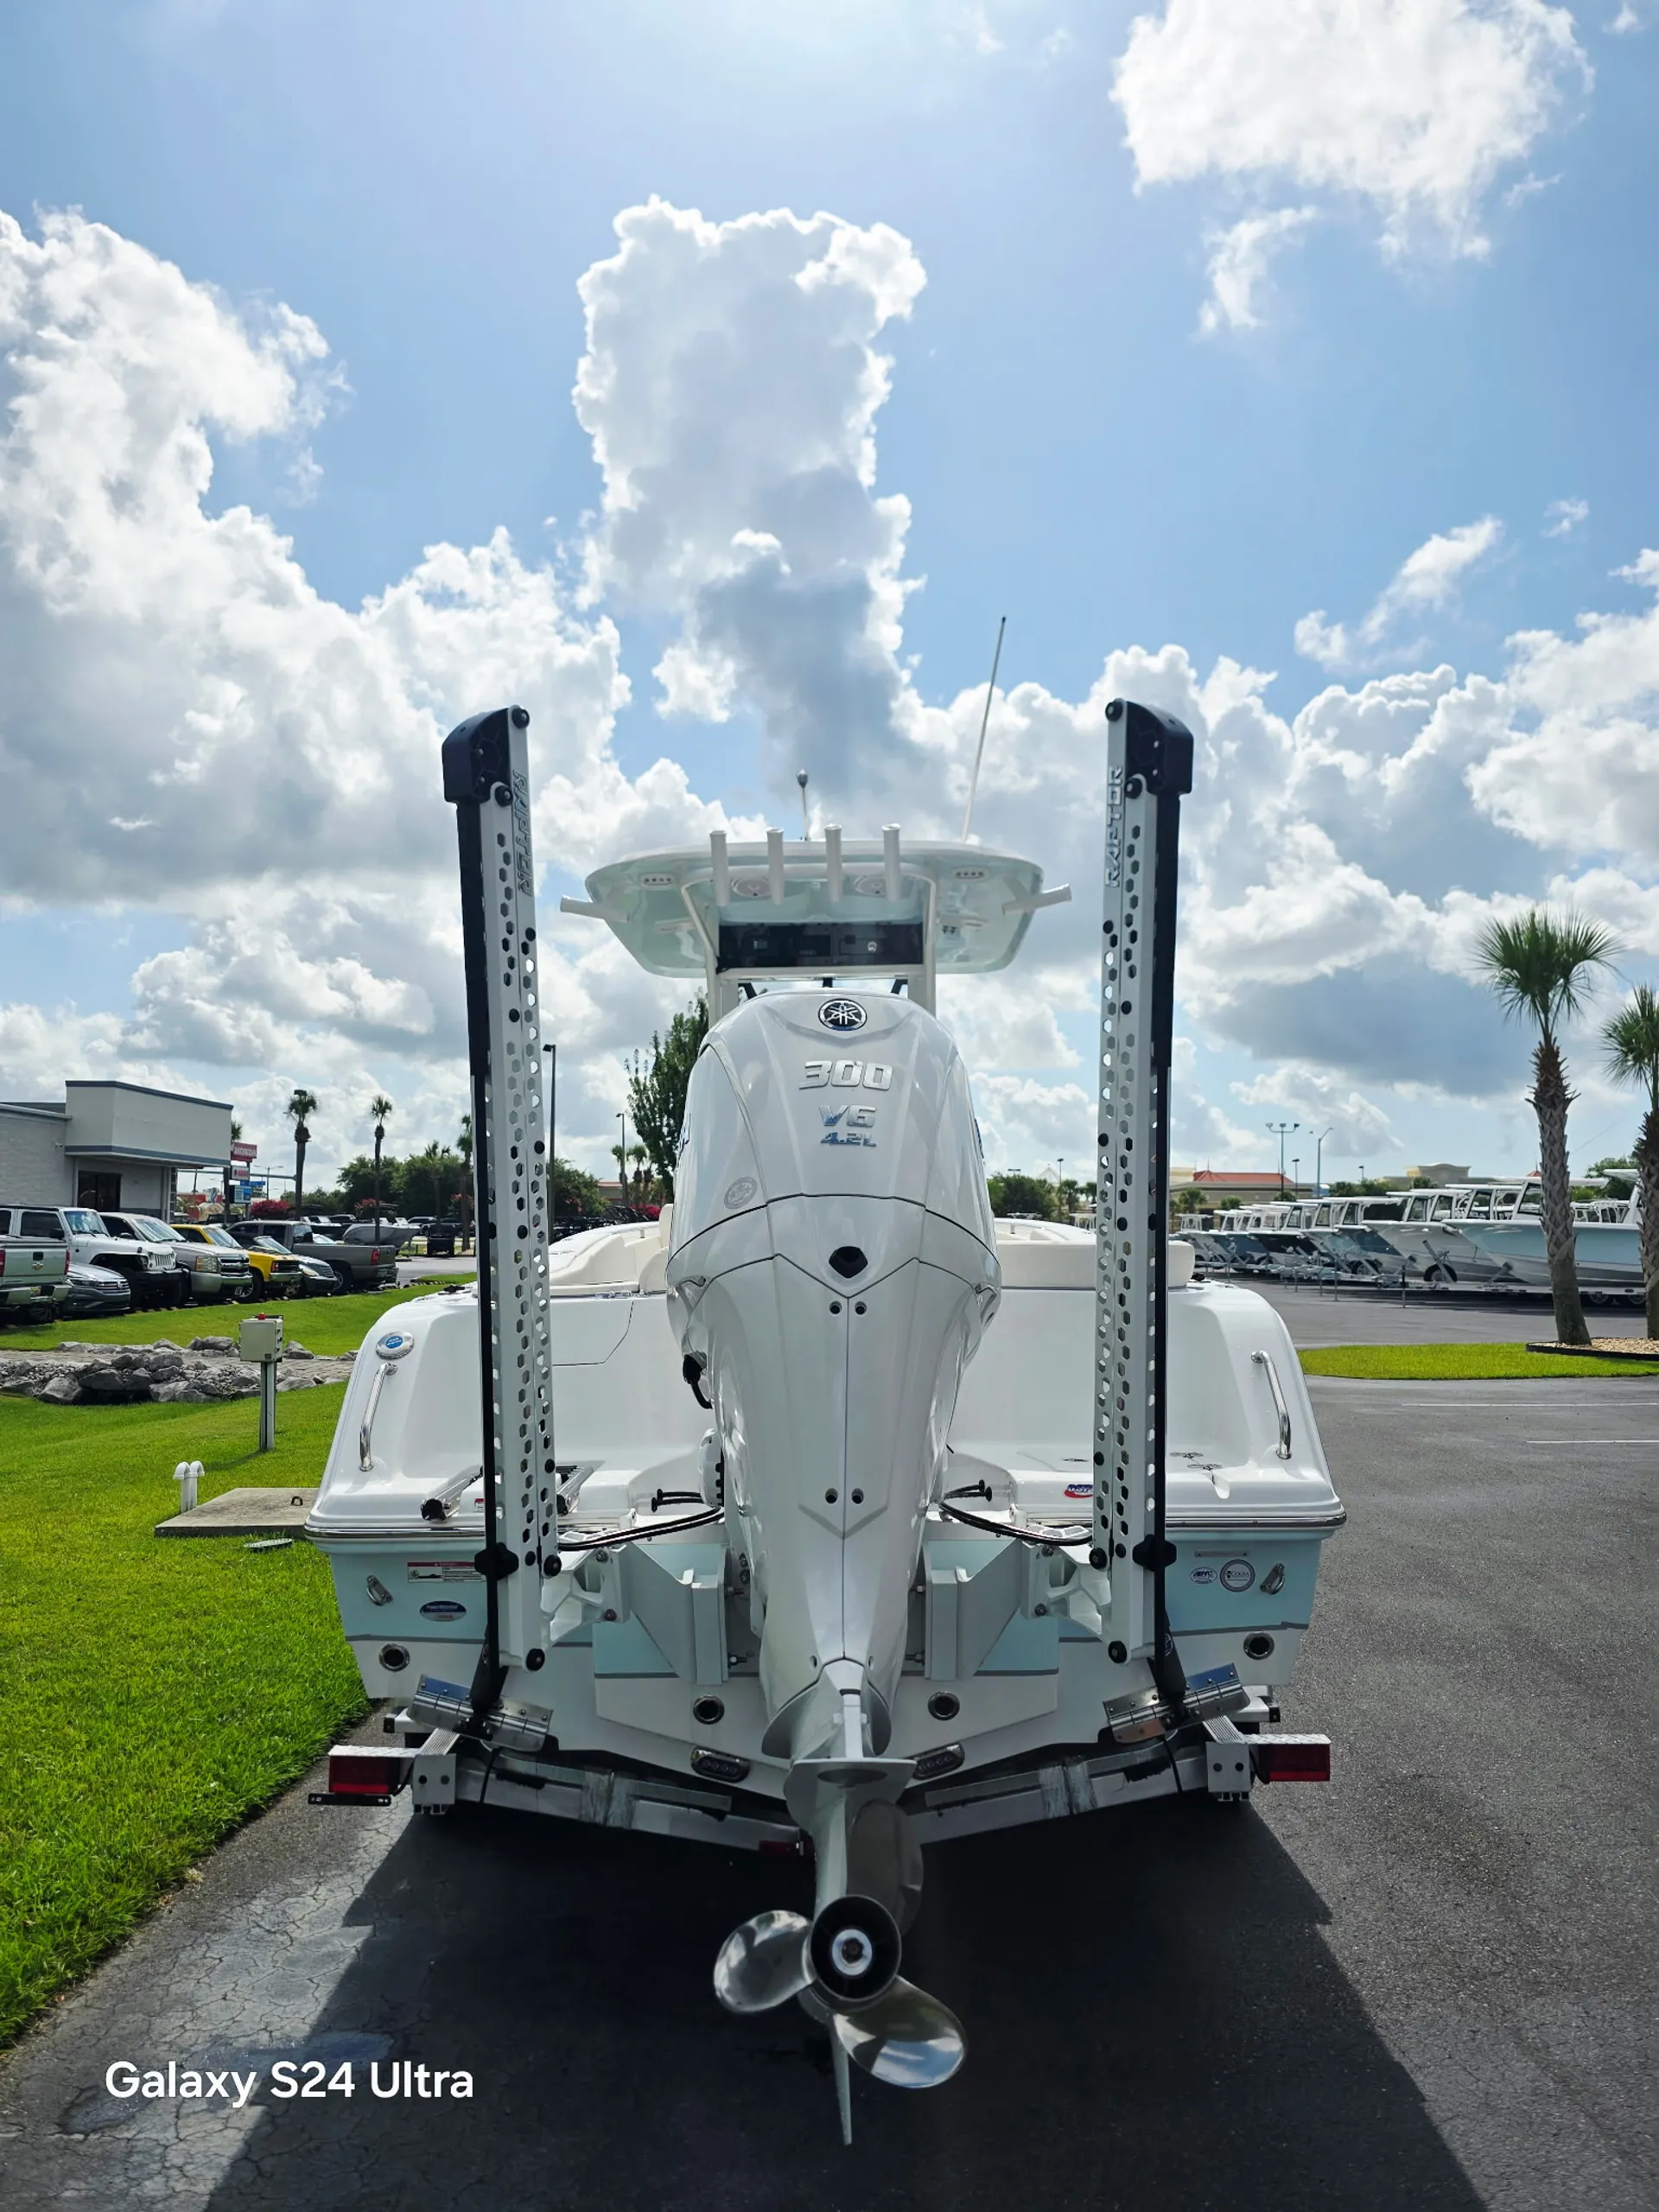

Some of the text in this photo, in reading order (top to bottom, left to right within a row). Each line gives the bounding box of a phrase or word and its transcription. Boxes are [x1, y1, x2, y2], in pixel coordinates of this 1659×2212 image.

[512, 769, 532, 897] RAPTOR
[1105, 766, 1122, 887] RAPTOR
[798, 1059, 893, 1091] 300
[819, 1104, 876, 1128] V6
[234, 1147, 257, 1157] HONDA
[821, 1131, 877, 1147] 4.2L
